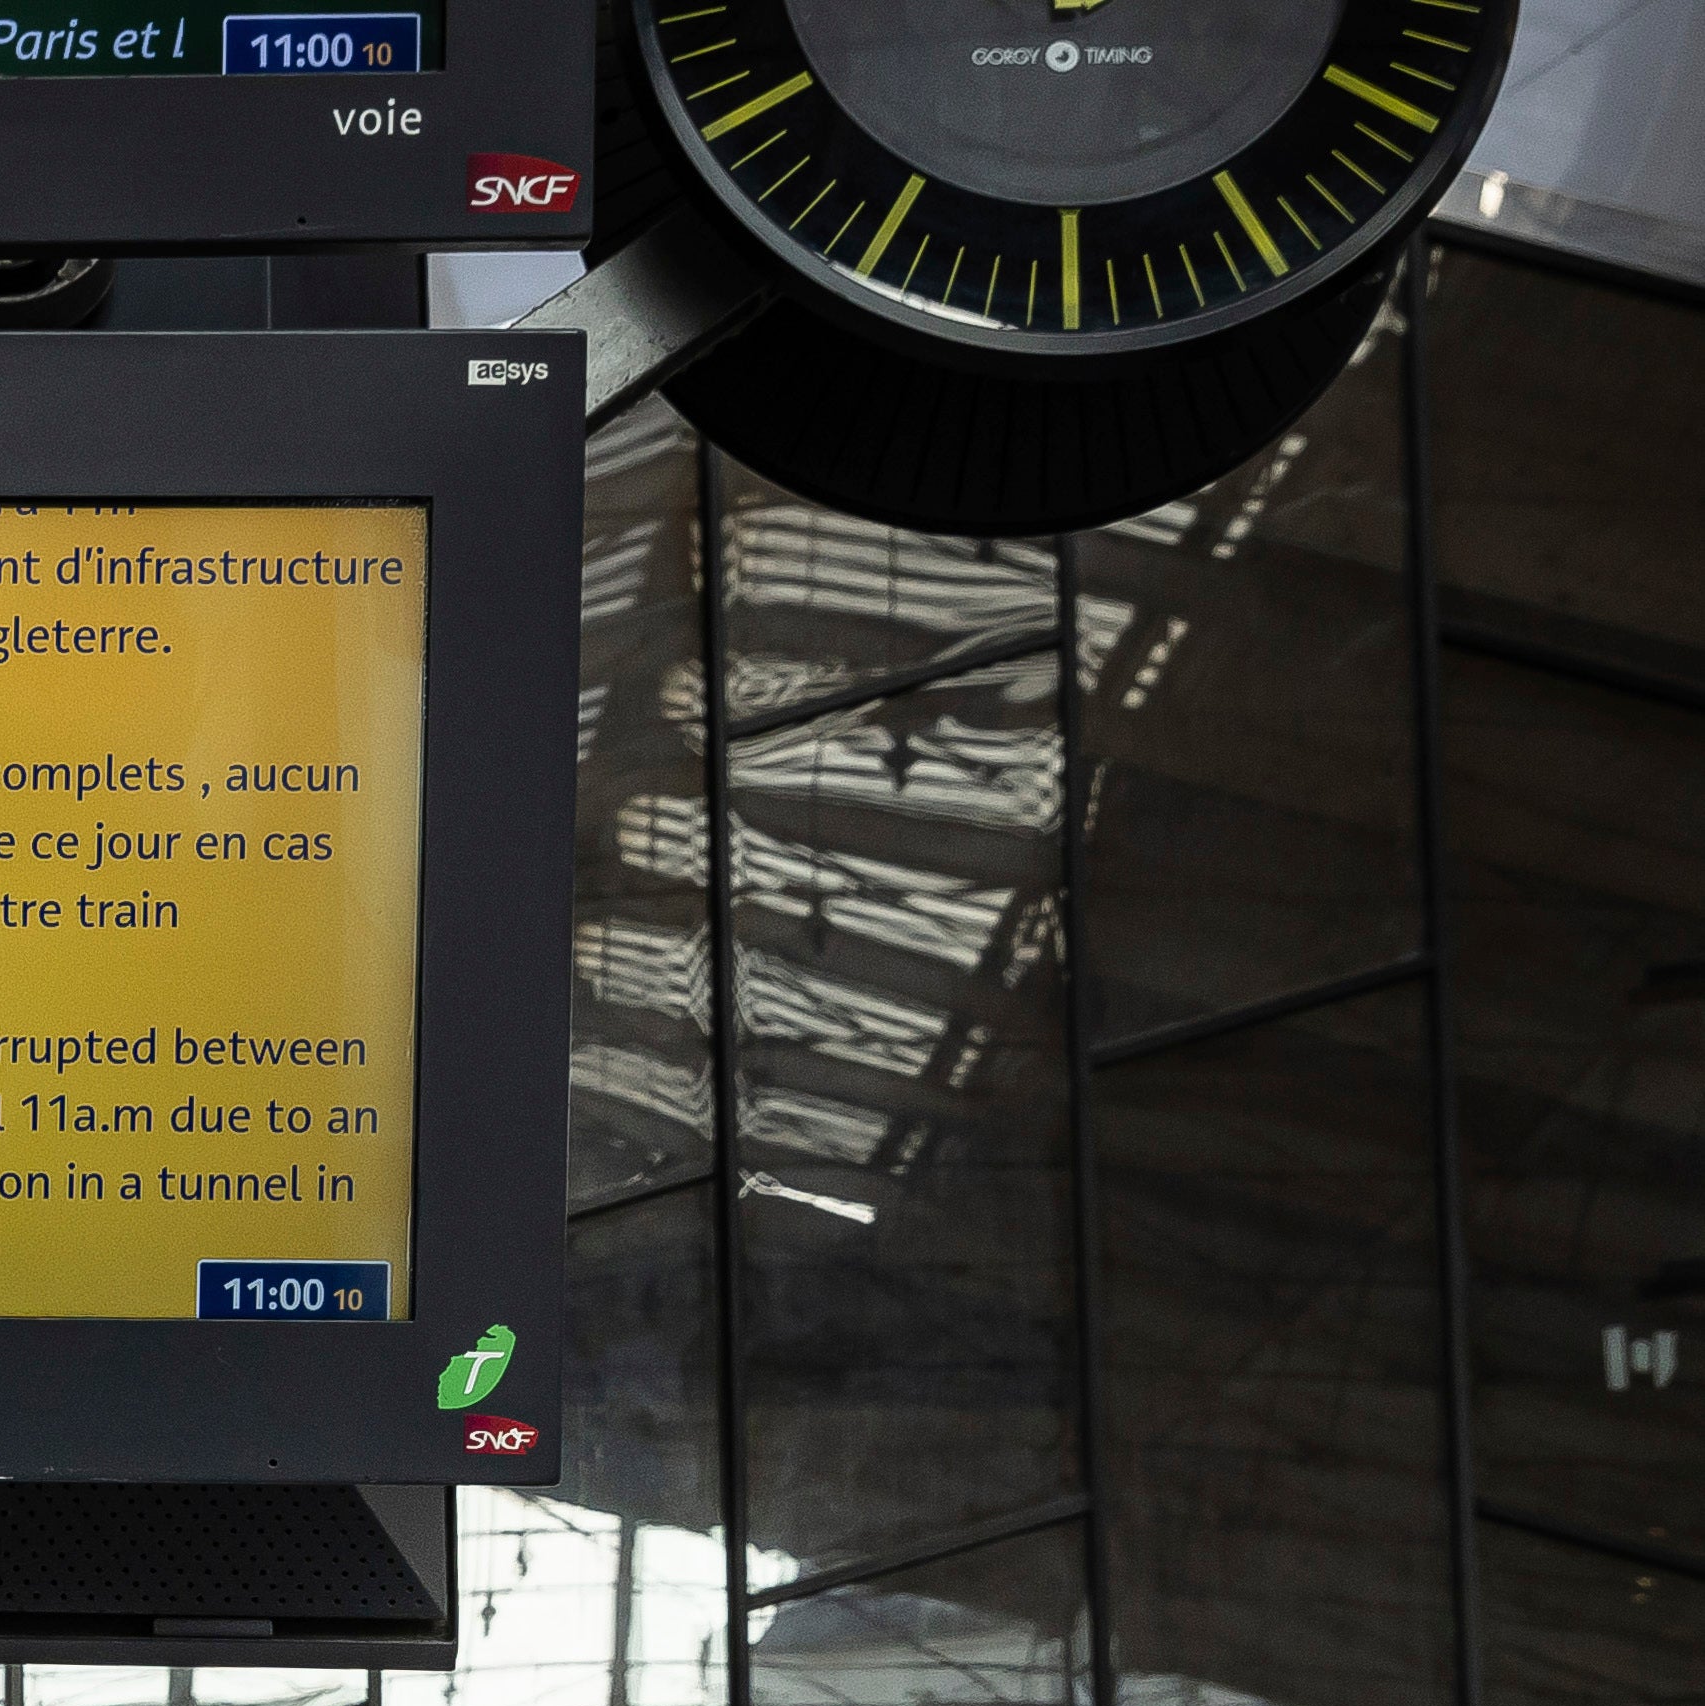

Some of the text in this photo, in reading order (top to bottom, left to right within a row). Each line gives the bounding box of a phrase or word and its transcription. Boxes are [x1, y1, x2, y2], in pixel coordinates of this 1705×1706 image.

[114, 23, 159, 58] et
[251, 33, 392, 68] 11:00 10
[1084, 46, 1154, 65] TIMING
[333, 98, 422, 136] voie
[470, 174, 575, 206] SNCF
[476, 361, 549, 385] aesys
[56, 546, 403, 585] d'infrastructure
[201, 782, 210, 800] ,
[226, 764, 359, 792] aucun
[31, 832, 80, 860] ce
[85, 821, 182, 871] jour
[195, 832, 246, 860] en
[263, 833, 333, 861] cas
[76, 890, 178, 928] train
[175, 1027, 365, 1066] between
[21, 1094, 152, 1133] 11a.m
[170, 1095, 251, 1133] due
[265, 1098, 312, 1134] to
[327, 1106, 378, 1134] an
[67, 1162, 104, 1200] in
[120, 1173, 141, 1200] a
[157, 1164, 303, 1202] tunnel
[317, 1164, 354, 1202] in
[223, 1279, 363, 1311] 11:00 10
